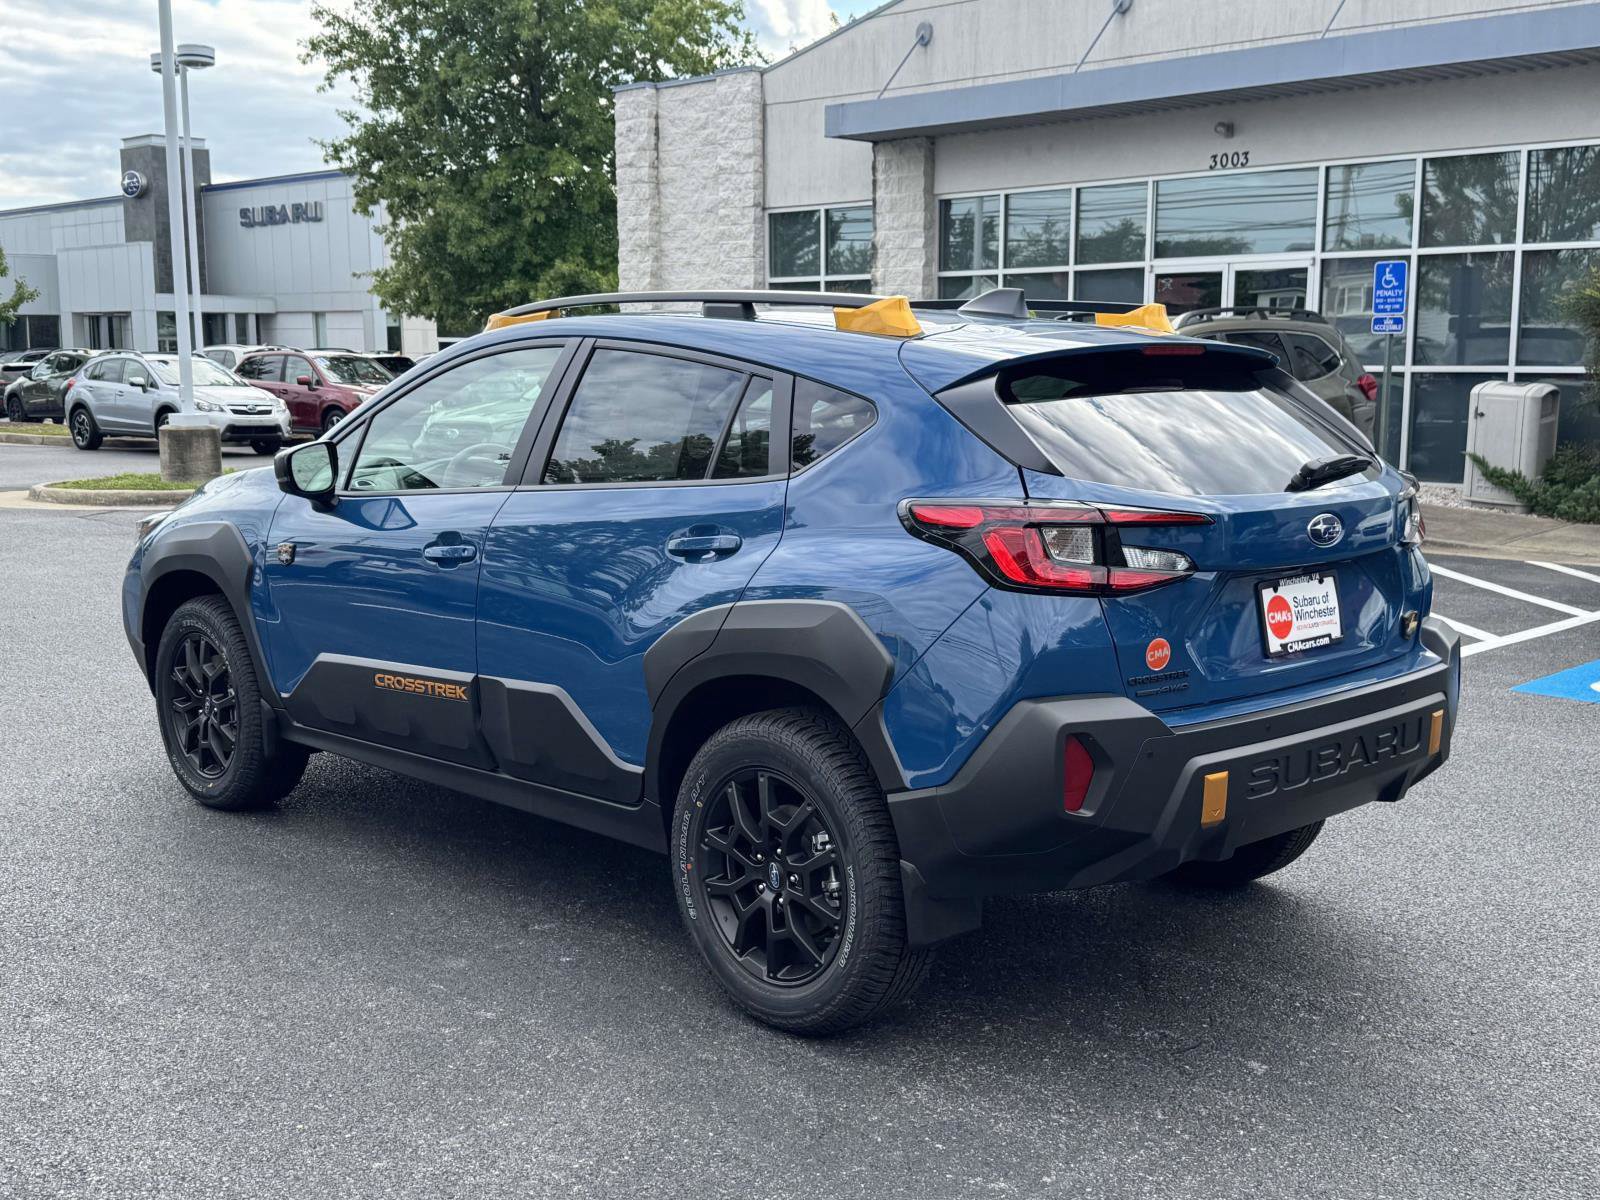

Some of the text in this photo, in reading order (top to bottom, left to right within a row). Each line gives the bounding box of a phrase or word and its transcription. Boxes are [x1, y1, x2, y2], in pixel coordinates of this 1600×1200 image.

[1209, 151, 1250, 170] 3003
[239, 201, 323, 228] SUBARU
[1376, 289, 1403, 298] PENALTY
[1312, 572, 1320, 581] VA
[1292, 592, 1329, 608] Subaru of
[1268, 610, 1292, 624] CMA's
[1294, 606, 1337, 621] Winchester
[1287, 637, 1330, 653] CMAcars.com
[1147, 647, 1169, 661] CMA
[374, 673, 468, 700] CROSSTREK
[1247, 715, 1423, 800] SUBARU
[679, 810, 697, 920] GEOLANDAR
[839, 865, 857, 968] YOKOHAMA
